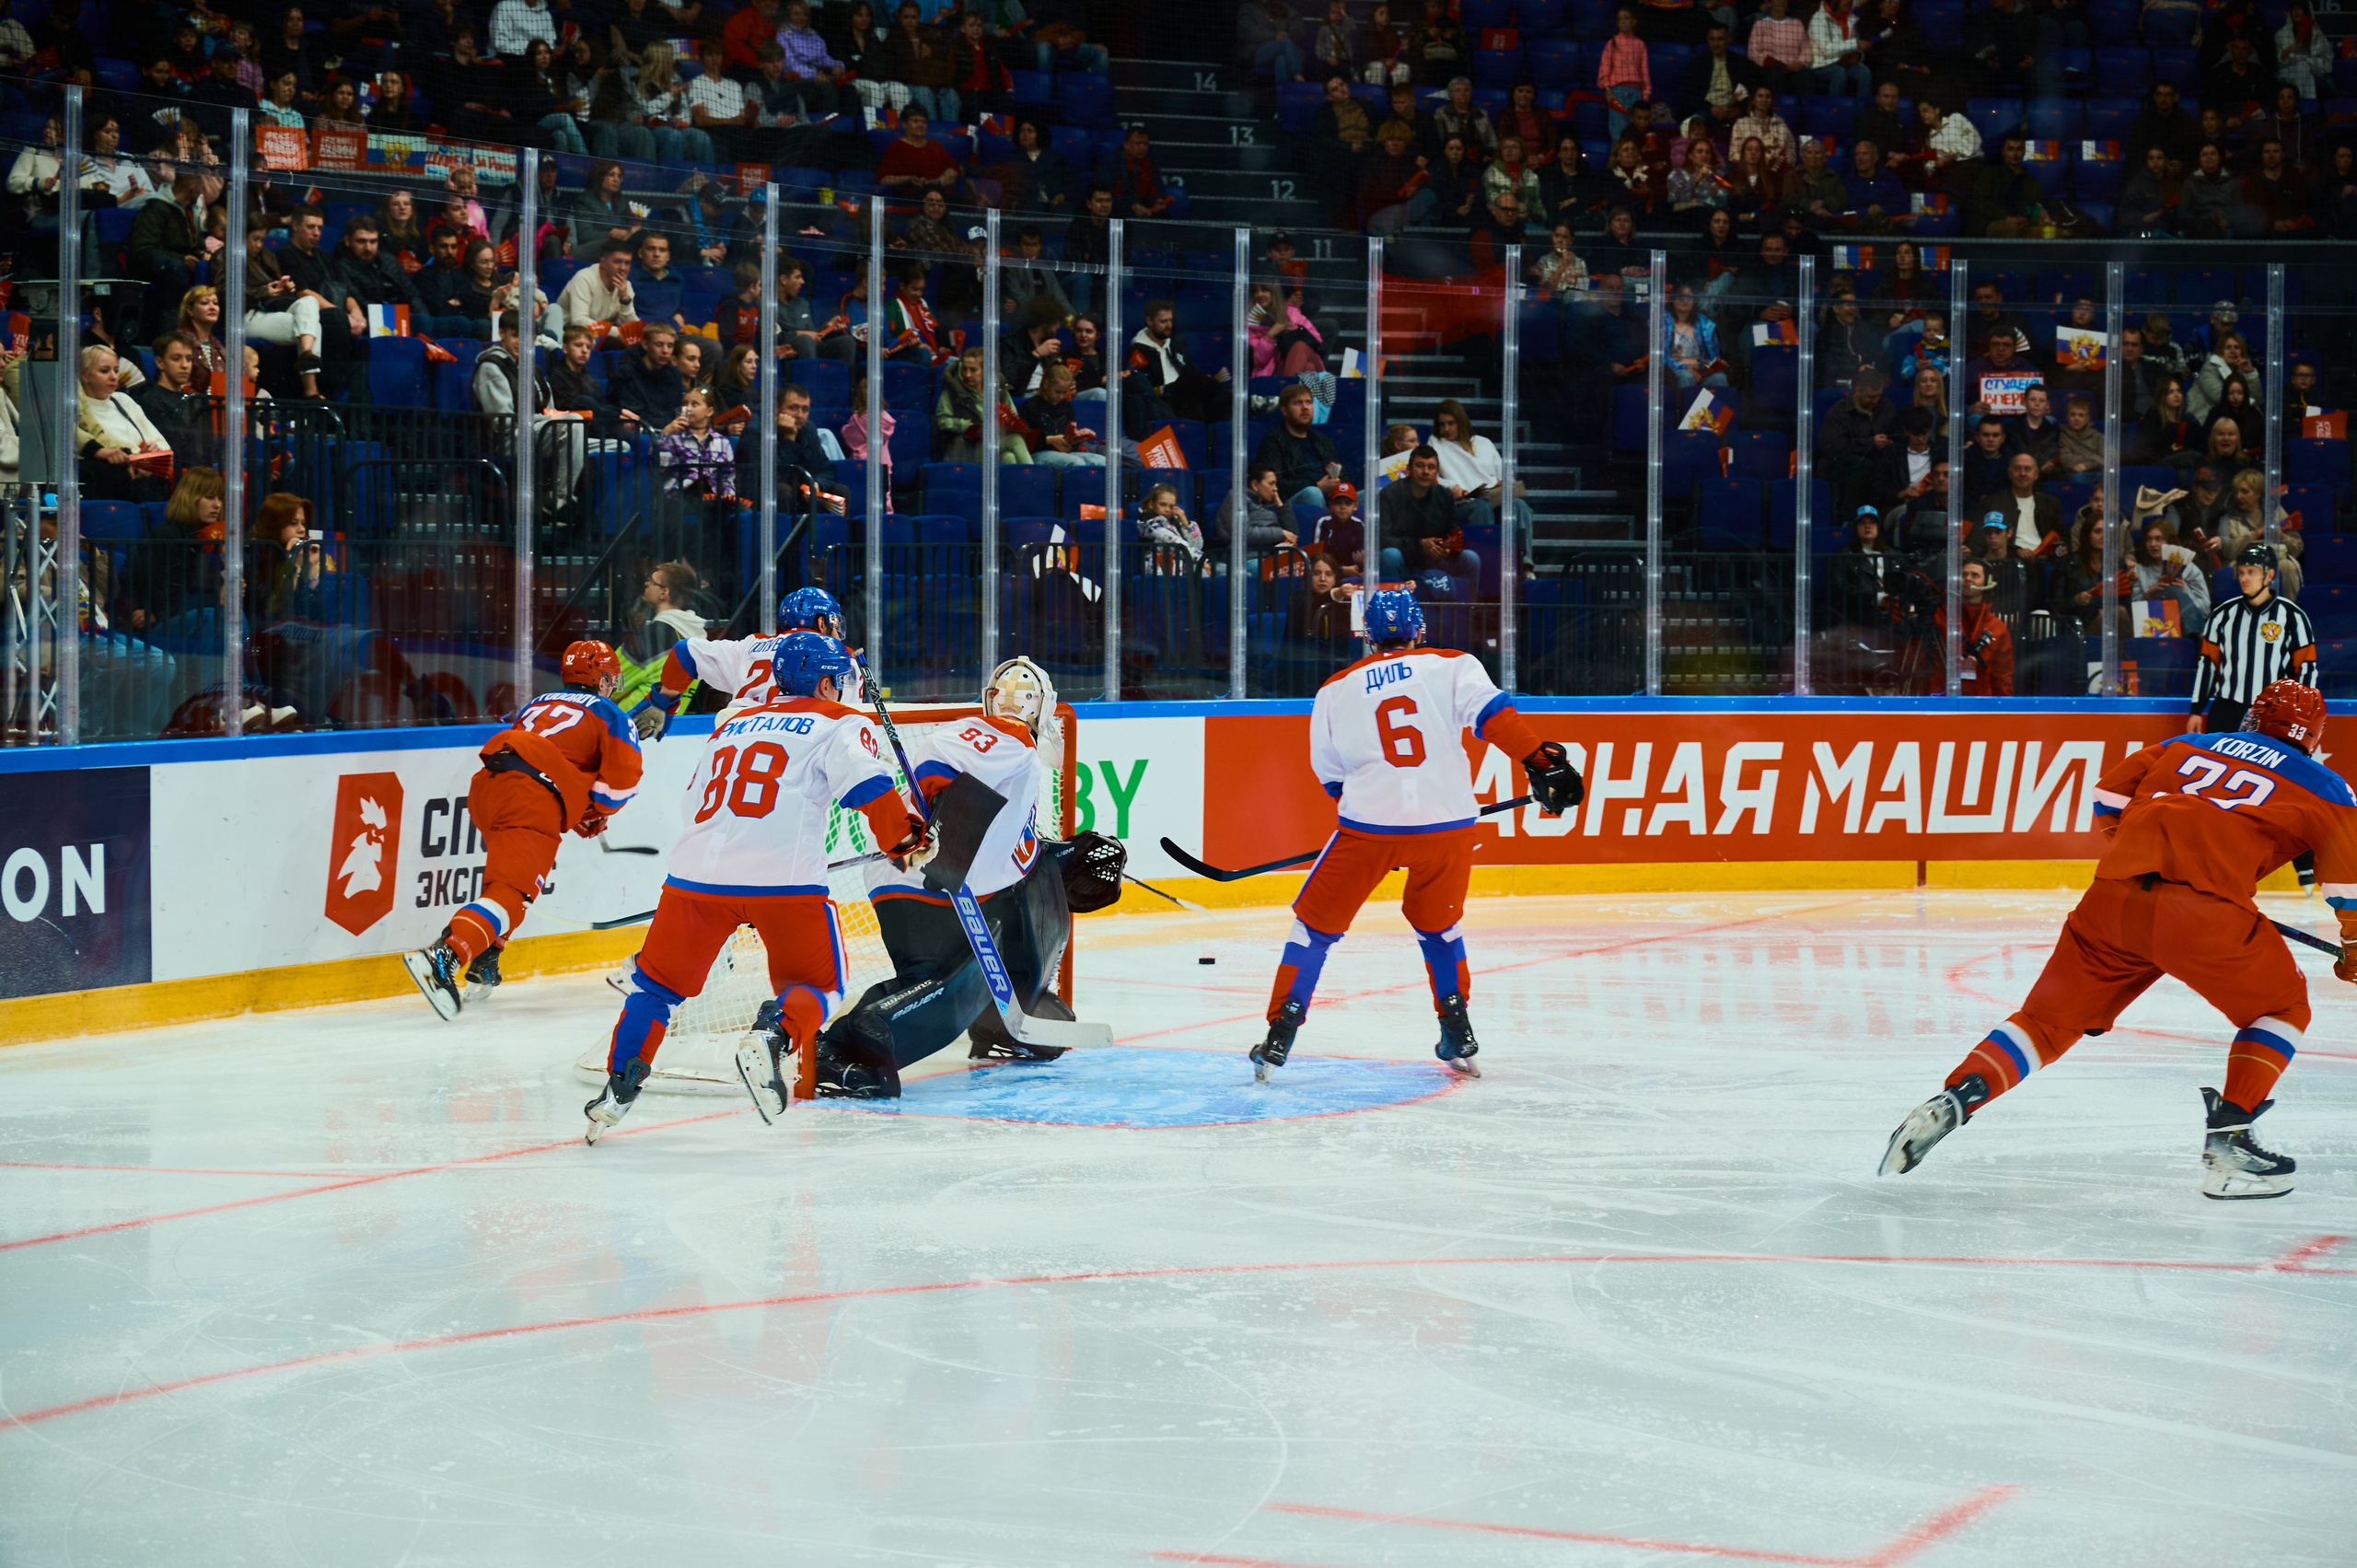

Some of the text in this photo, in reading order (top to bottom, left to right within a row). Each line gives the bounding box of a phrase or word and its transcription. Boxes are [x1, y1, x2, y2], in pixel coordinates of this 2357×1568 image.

[1194, 72, 1217, 92] 14
[1229, 126, 1254, 145] 13
[1271, 180, 1295, 200] 12
[1313, 239, 1332, 259] 11
[565, 655, 575, 666] 32
[1366, 661, 1412, 694] ДИЛЬ
[861, 667, 900, 742] SHADOW
[715, 716, 816, 740] РИСТАЛОВ
[1375, 694, 1427, 768] 6
[2287, 723, 2307, 741] 33
[2210, 738, 2288, 769] KORZIN
[694, 740, 790, 824] 88
[1473, 741, 1784, 837] АСНАЯ
[1, 843, 106, 923] ON
[958, 897, 1009, 993] BAUER
[890, 987, 946, 1021] BAUER
